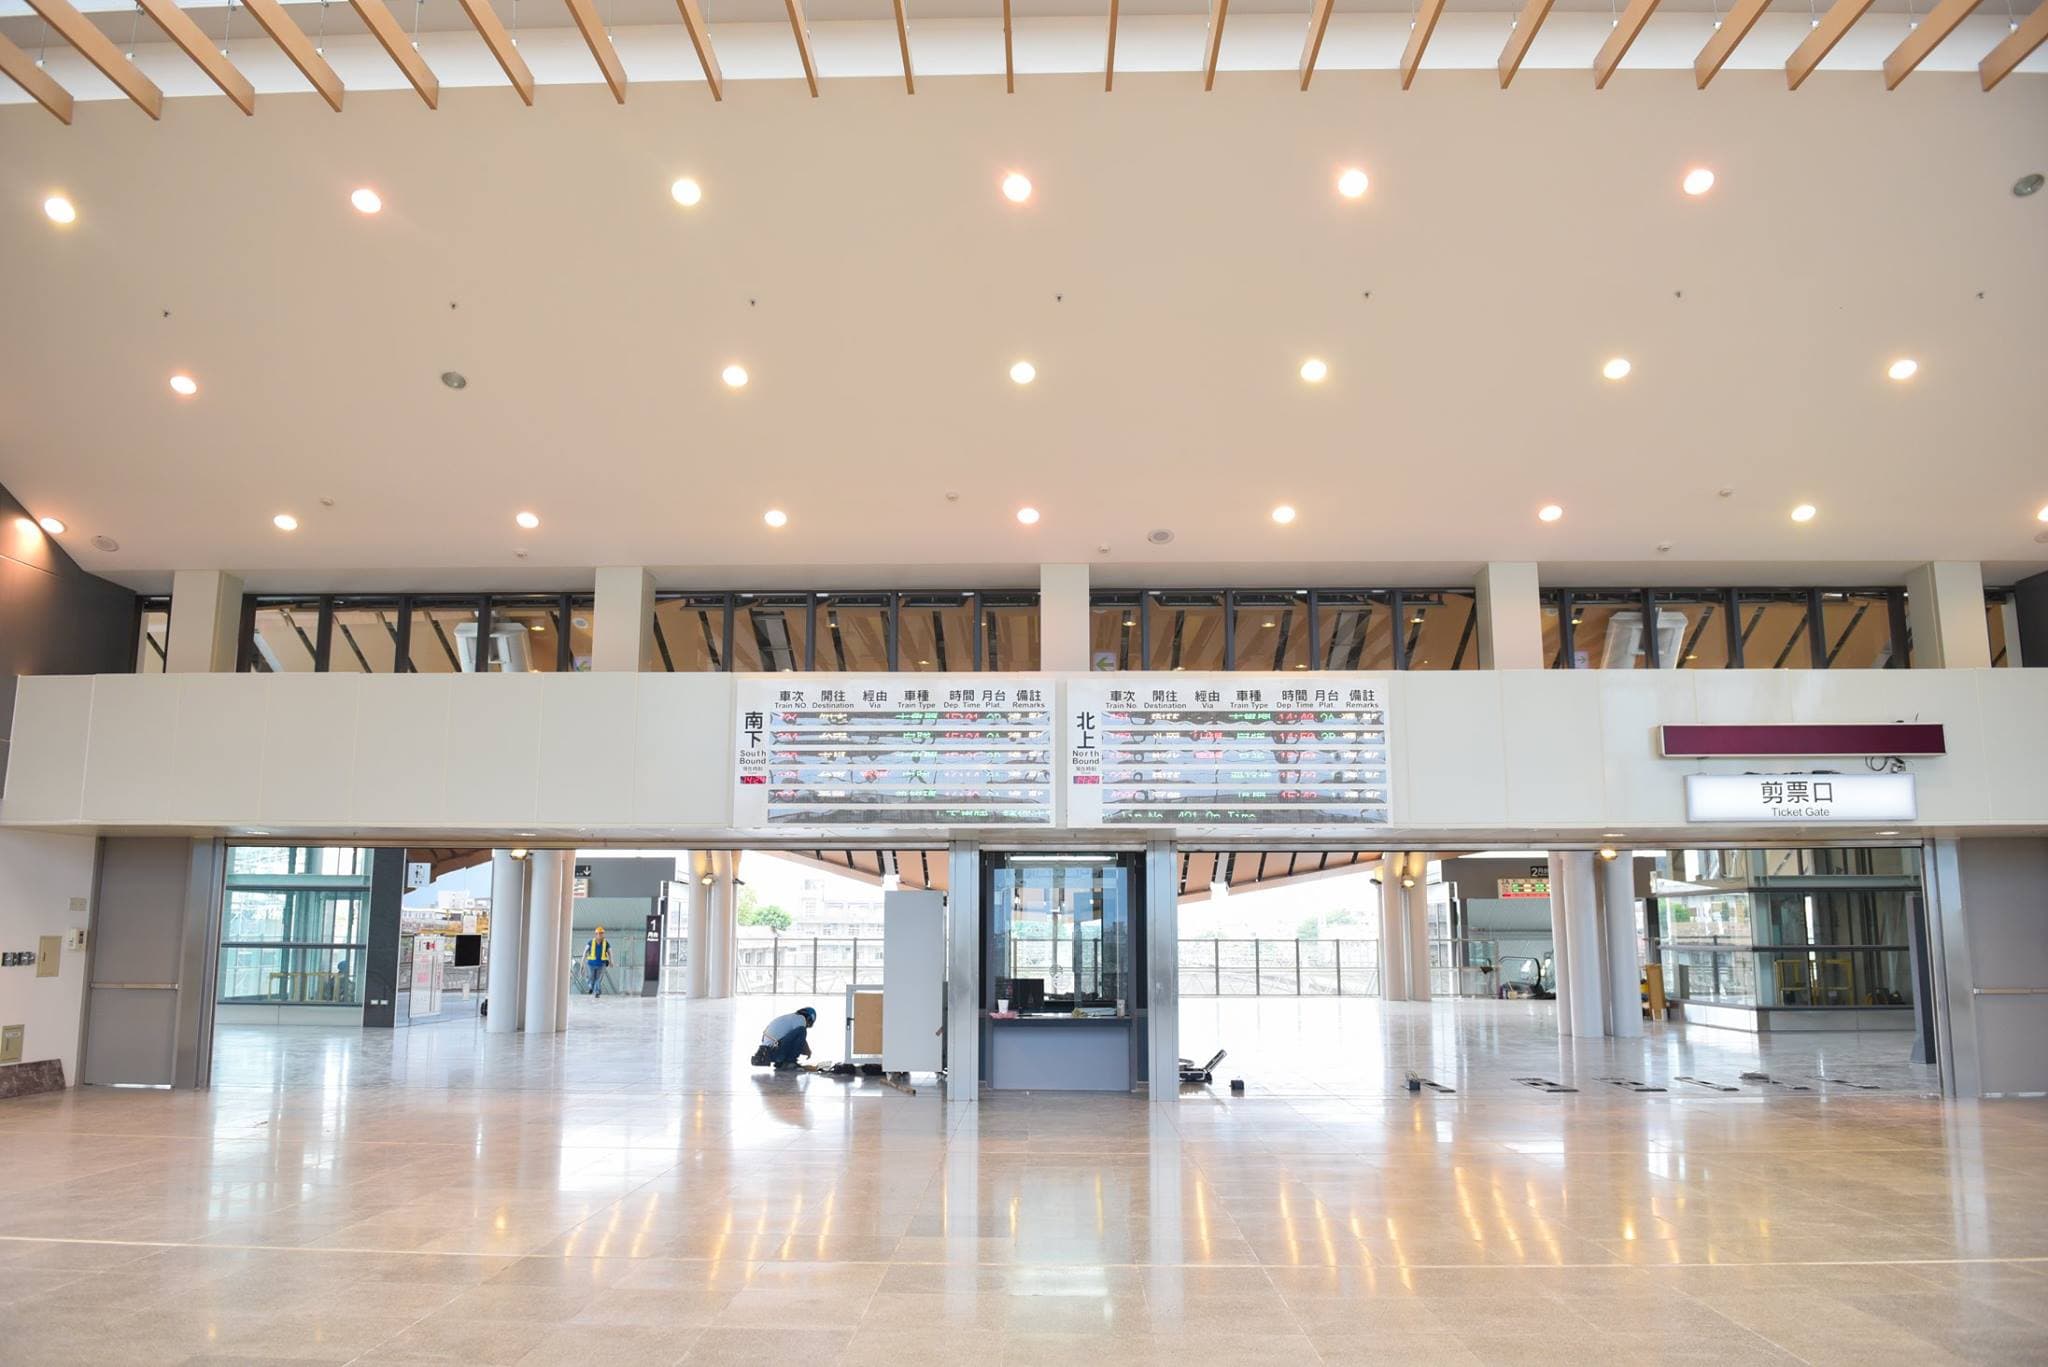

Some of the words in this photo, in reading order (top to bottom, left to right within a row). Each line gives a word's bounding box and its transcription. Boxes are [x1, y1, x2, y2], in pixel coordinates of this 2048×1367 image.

[780, 691, 804, 702] 車次
[821, 690, 846, 701] 開往
[863, 690, 887, 701] 經由
[904, 690, 929, 701] 車種
[950, 690, 974, 701] 時間
[982, 690, 1006, 701] 月台
[1017, 690, 1041, 701] 備註
[1110, 691, 1135, 701] 車次
[1153, 691, 1177, 702] 開往
[1195, 691, 1220, 702] 經由
[1236, 690, 1261, 701] 車種
[1282, 690, 1307, 701] 時間
[1315, 690, 1338, 701] 月台
[1349, 690, 1374, 701] 備註
[745, 712, 763, 748] 南下
[1077, 712, 1095, 749] 北上
[1761, 781, 1833, 803] 剪票口
[1772, 807, 1803, 817] Ticket
[1805, 807, 1830, 817] Gate
